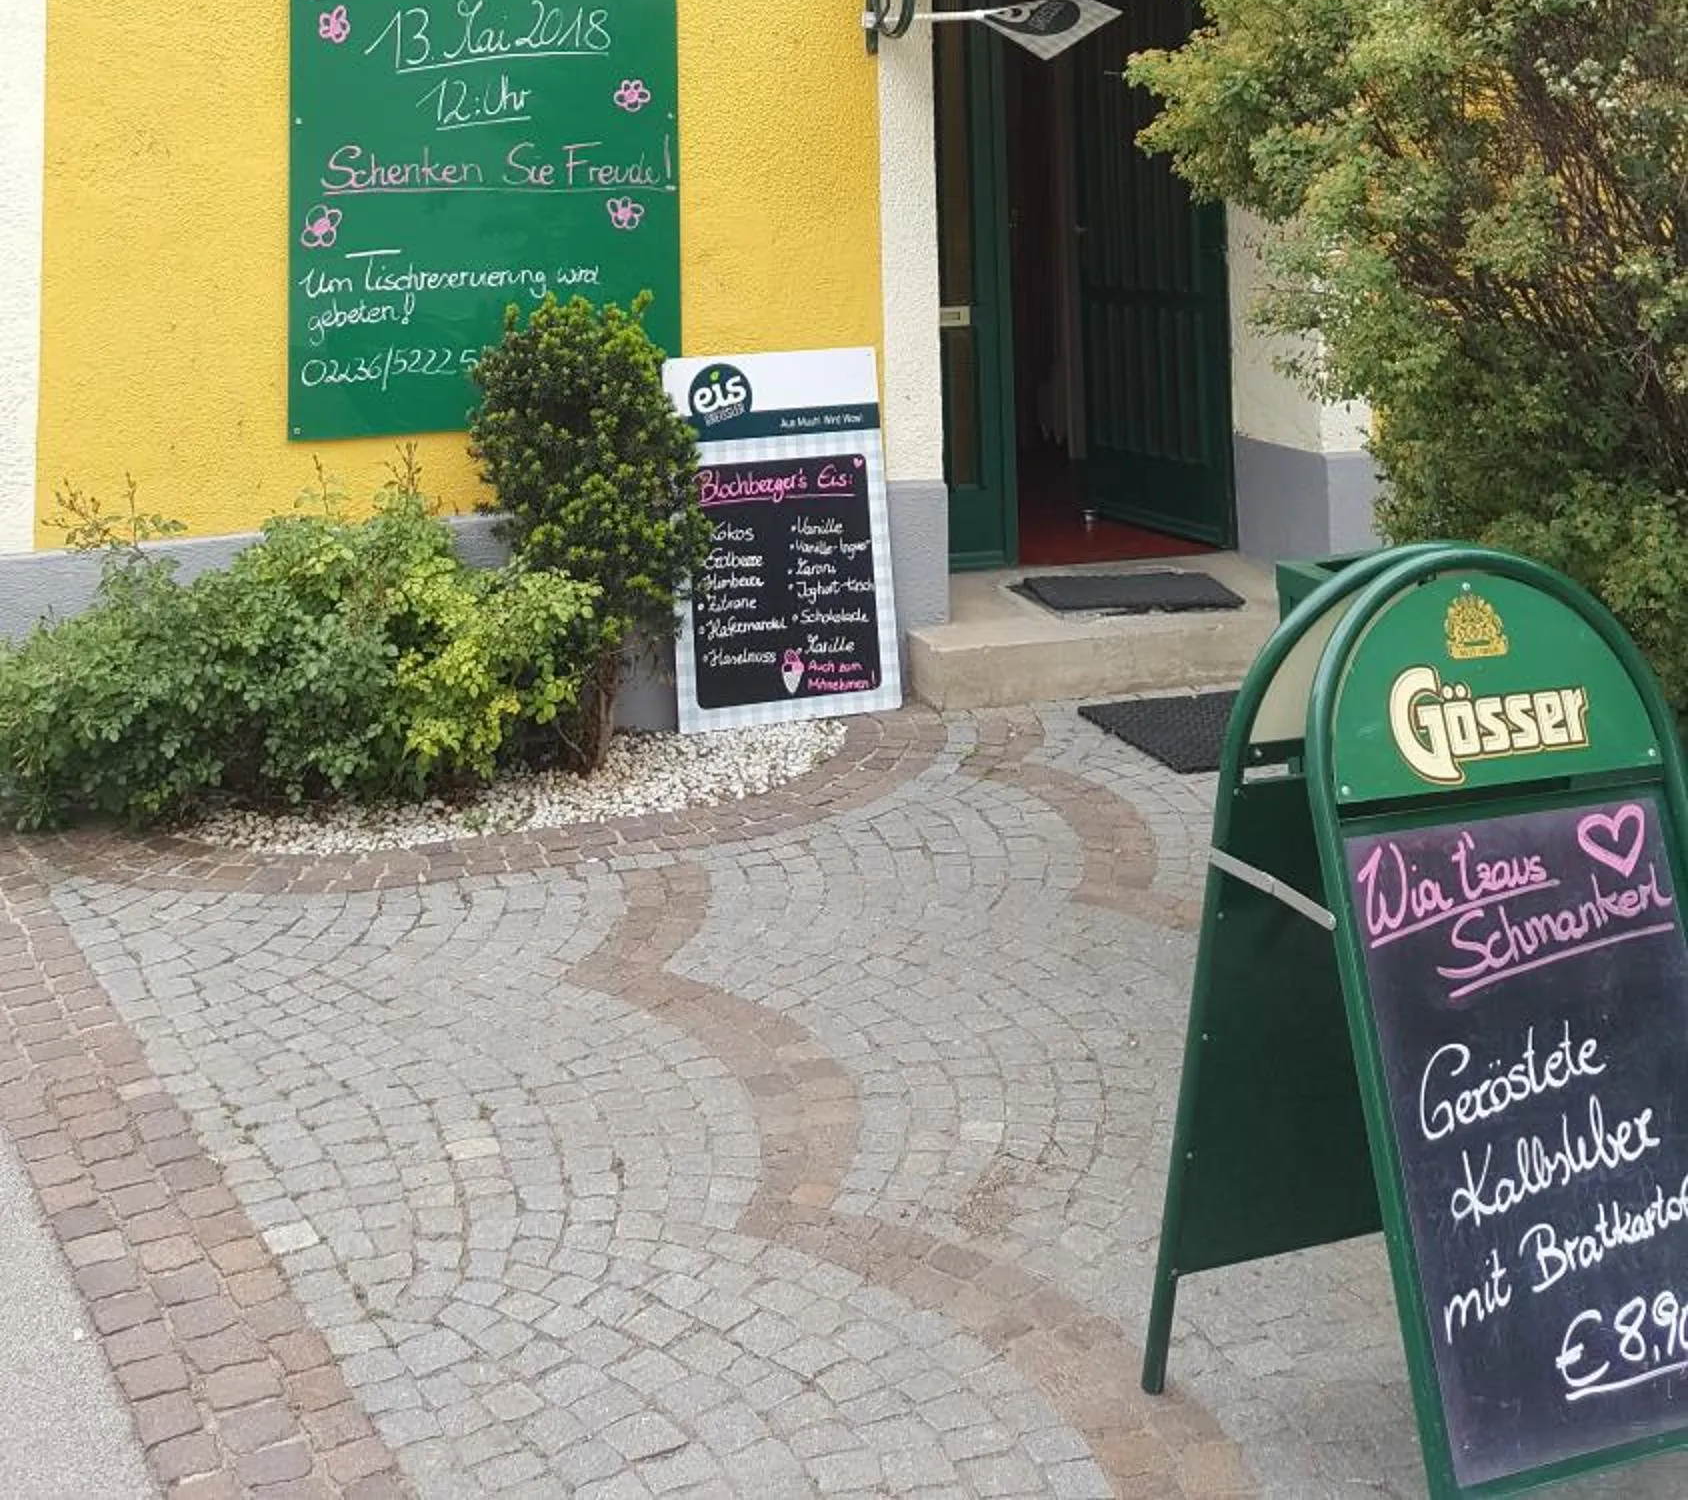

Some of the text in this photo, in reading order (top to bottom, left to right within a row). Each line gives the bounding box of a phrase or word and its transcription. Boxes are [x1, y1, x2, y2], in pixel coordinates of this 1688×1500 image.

[365, 0, 612, 69] 13. Mai 2018
[320, 133, 677, 191] Schenken Sie Freude!
[298, 267, 353, 298] Um
[556, 265, 600, 286] wird
[307, 292, 417, 347] gebeten!
[693, 371, 747, 414] eis
[1388, 664, 1589, 784] Gösser
[1357, 841, 1454, 936] Wia
[1436, 861, 1672, 978] Schmankerl
[1419, 1019, 1607, 1140] Geröstete
[1451, 1094, 1661, 1227] Kalbsleber
[1442, 1250, 1513, 1343] mit
